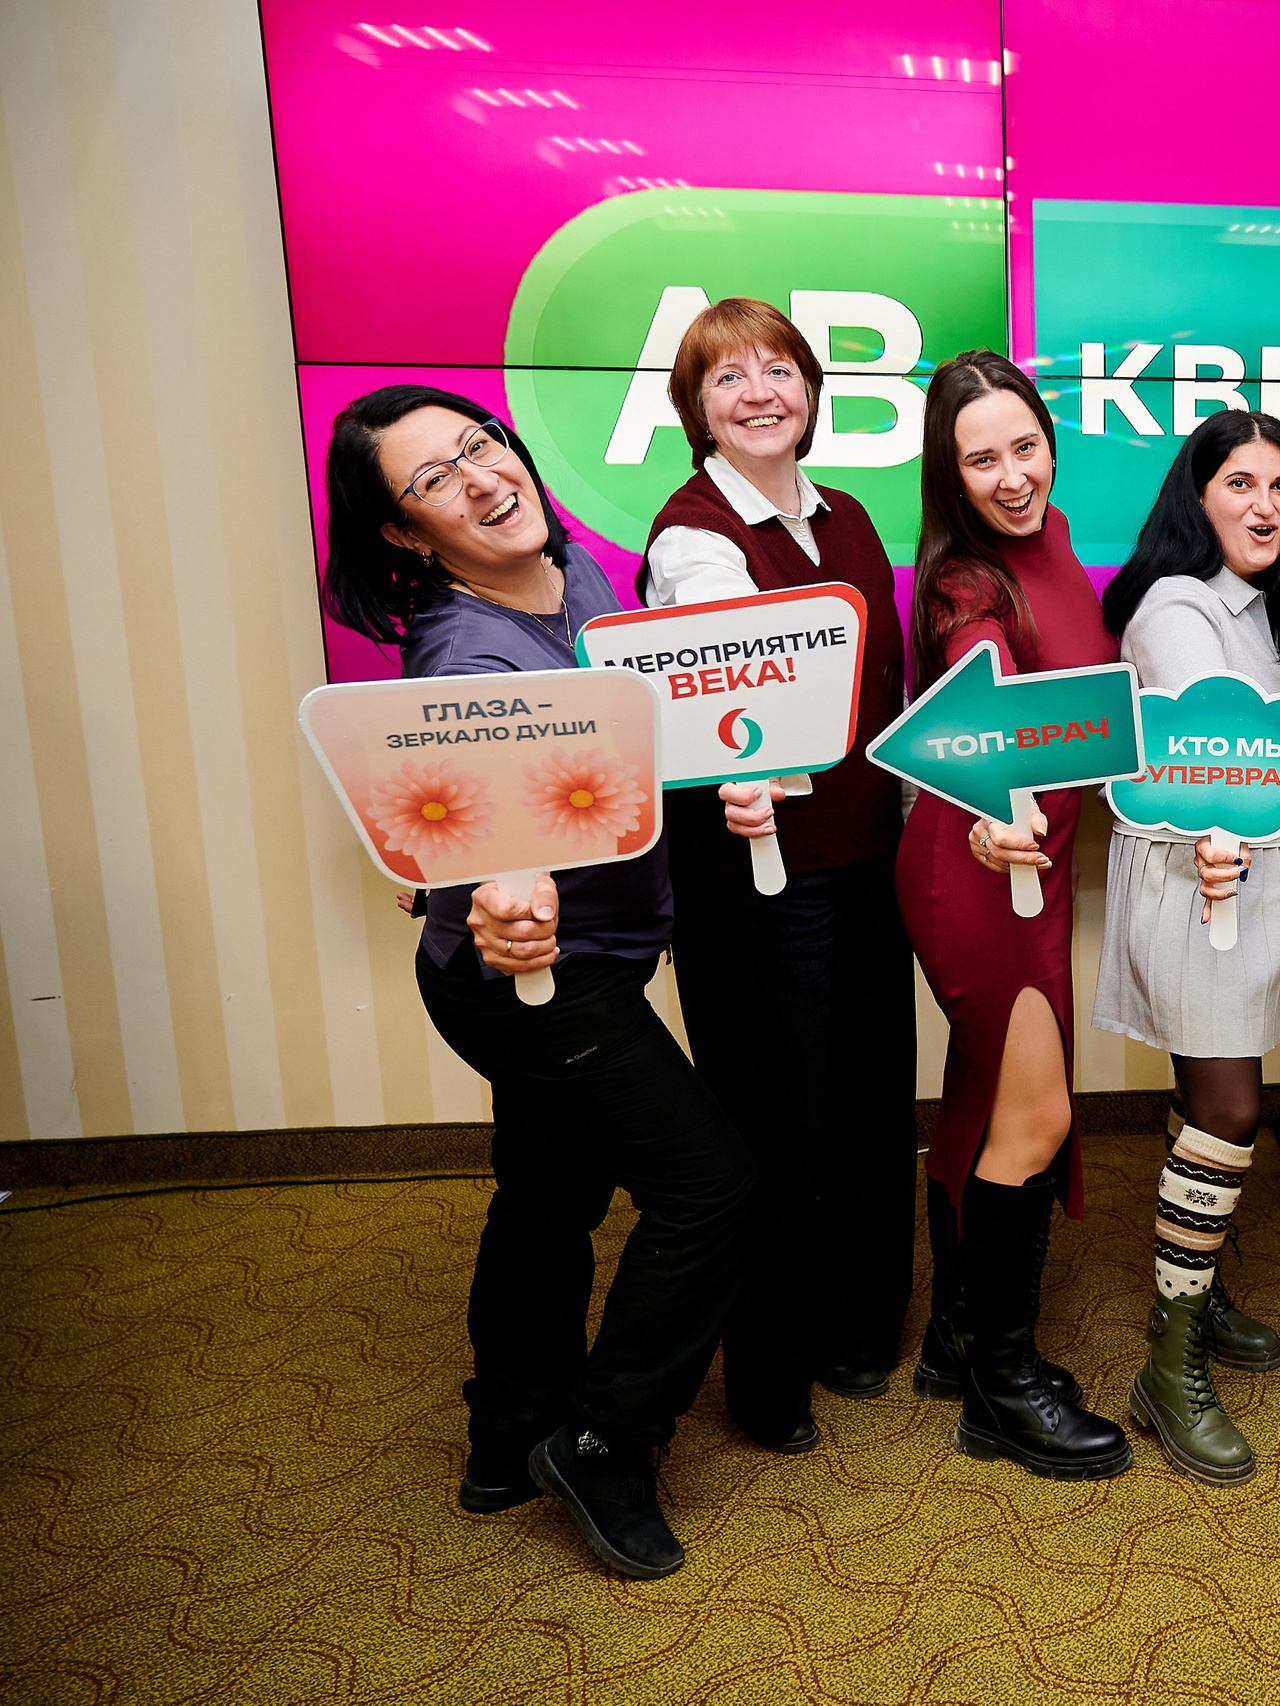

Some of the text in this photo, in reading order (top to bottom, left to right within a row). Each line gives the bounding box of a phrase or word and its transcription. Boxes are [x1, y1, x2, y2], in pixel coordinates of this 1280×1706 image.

[667, 656, 797, 701] ВЕКА!
[422, 697, 532, 723] ГЛАЗА
[386, 719, 597, 750] ЗЕРКАЛО ДУШИ
[927, 718, 1110, 759] ТОП-ВРАЧ
[1168, 735, 1230, 757] КТО
